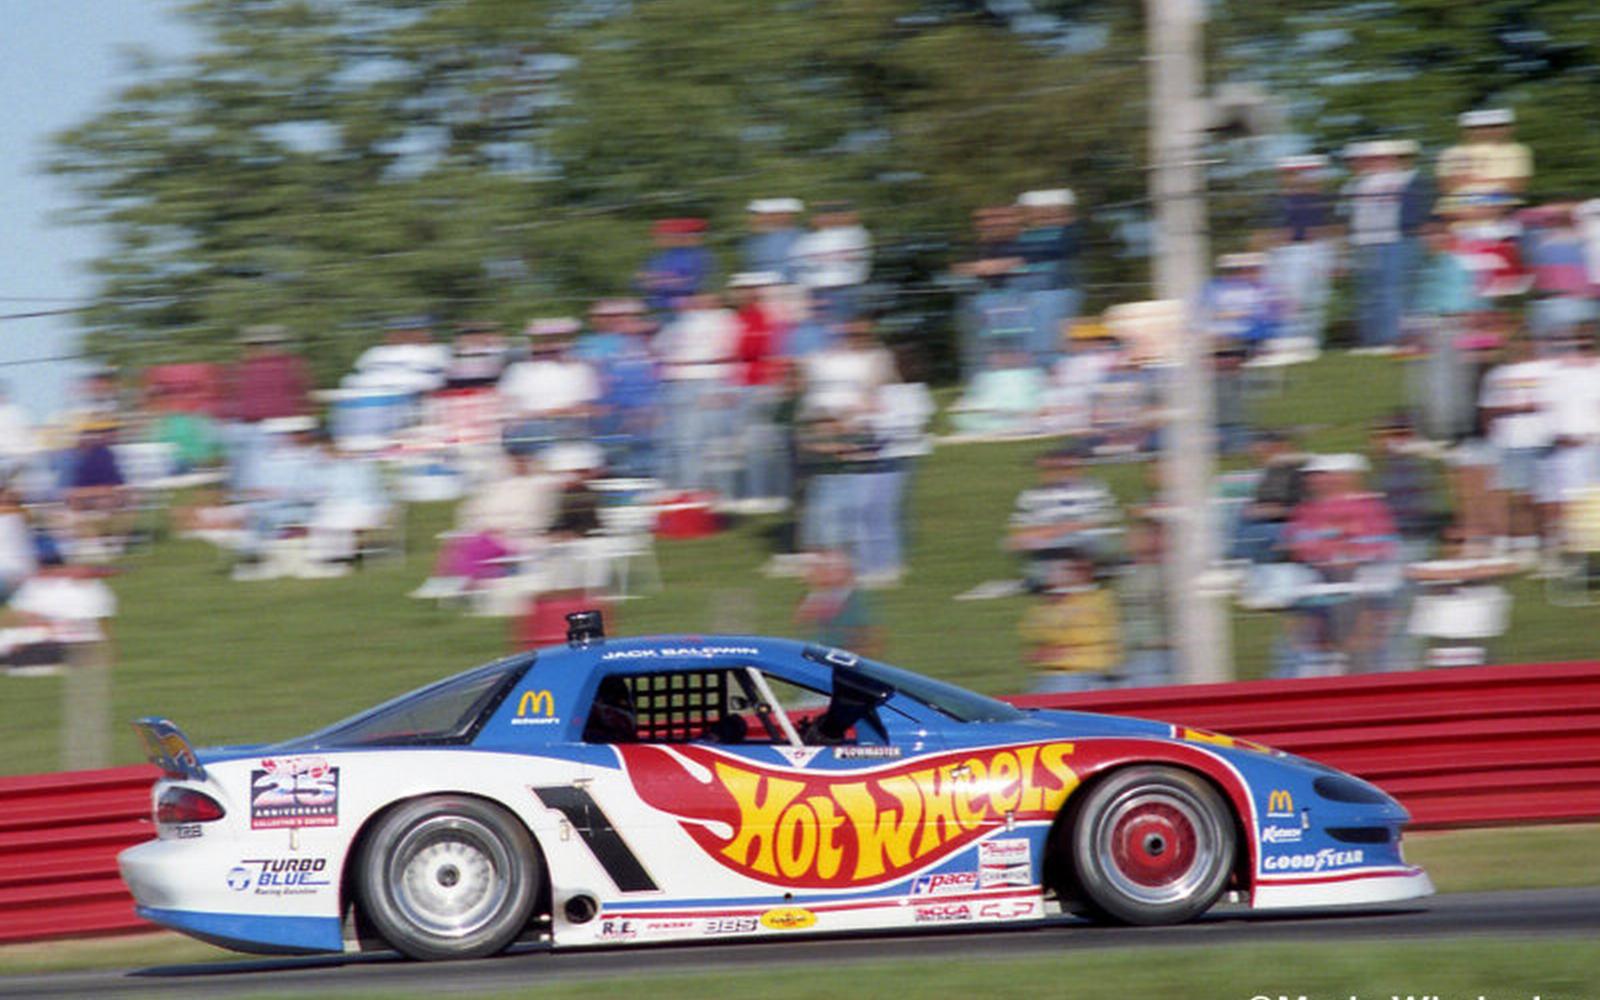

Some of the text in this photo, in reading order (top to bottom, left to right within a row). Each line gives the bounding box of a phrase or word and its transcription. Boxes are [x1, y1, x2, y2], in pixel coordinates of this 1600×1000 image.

[602, 647, 759, 660] JACK BALDWIN
[241, 858, 327, 872] TURBO
[1264, 849, 1363, 872] GOODYEAR
[257, 872, 331, 886] BLUE
